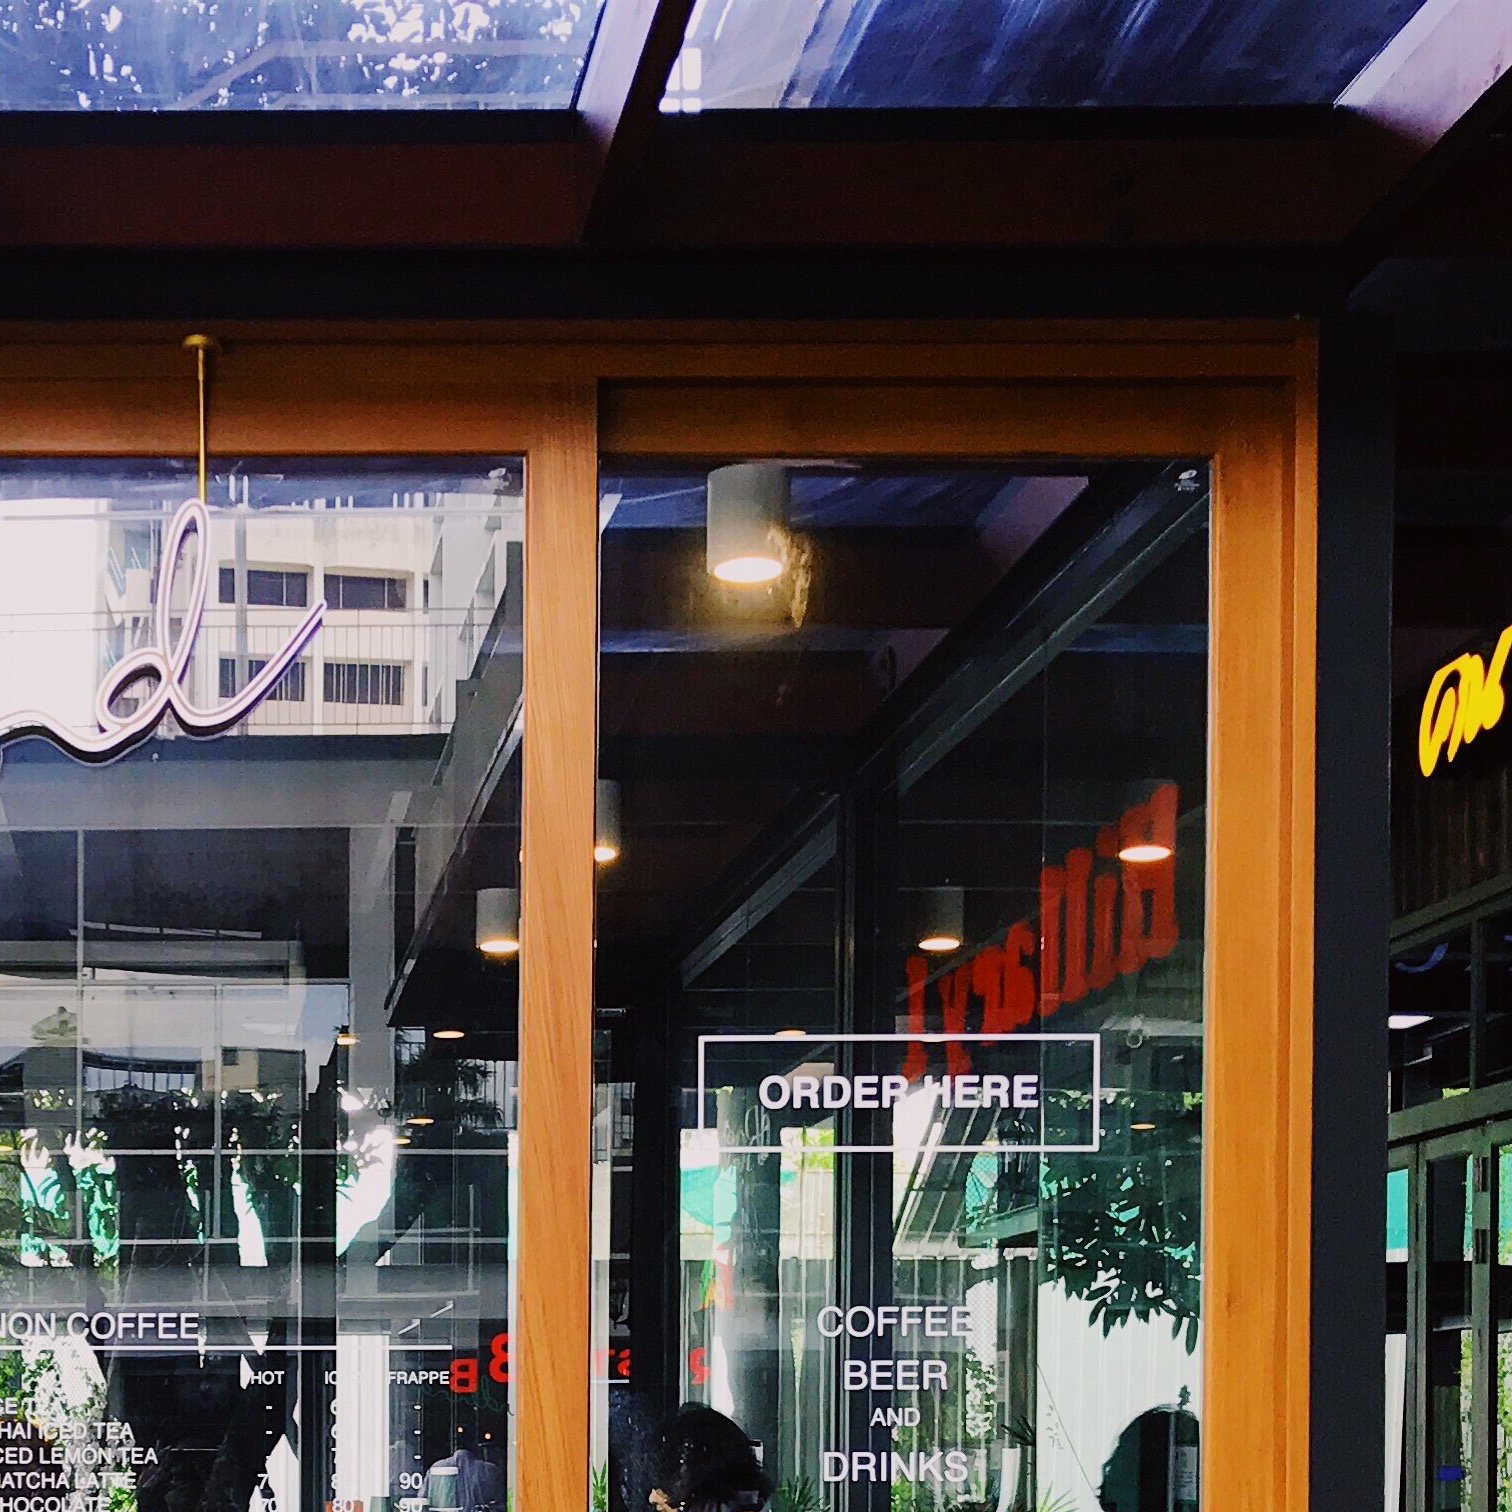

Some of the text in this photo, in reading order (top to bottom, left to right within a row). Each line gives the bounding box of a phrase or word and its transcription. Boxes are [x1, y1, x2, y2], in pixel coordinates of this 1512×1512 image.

[758, 1074, 1039, 1110] ORDER HERE
[67, 1312, 200, 1339] COFFEE
[817, 1306, 974, 1338] COFFEE
[251, 1371, 285, 1385] HOT
[388, 1371, 450, 1385] FRAPPE
[844, 1359, 948, 1391] BEER
[870, 1407, 921, 1427] AND
[39, 1422, 87, 1440] ICED
[92, 1422, 135, 1440] TEA
[39, 1447, 112, 1465] LEMON
[116, 1447, 158, 1465] TEA
[823, 1451, 969, 1483] DRINKS
[75, 1472, 137, 1490] LATTE
[399, 1472, 423, 1490] 90
